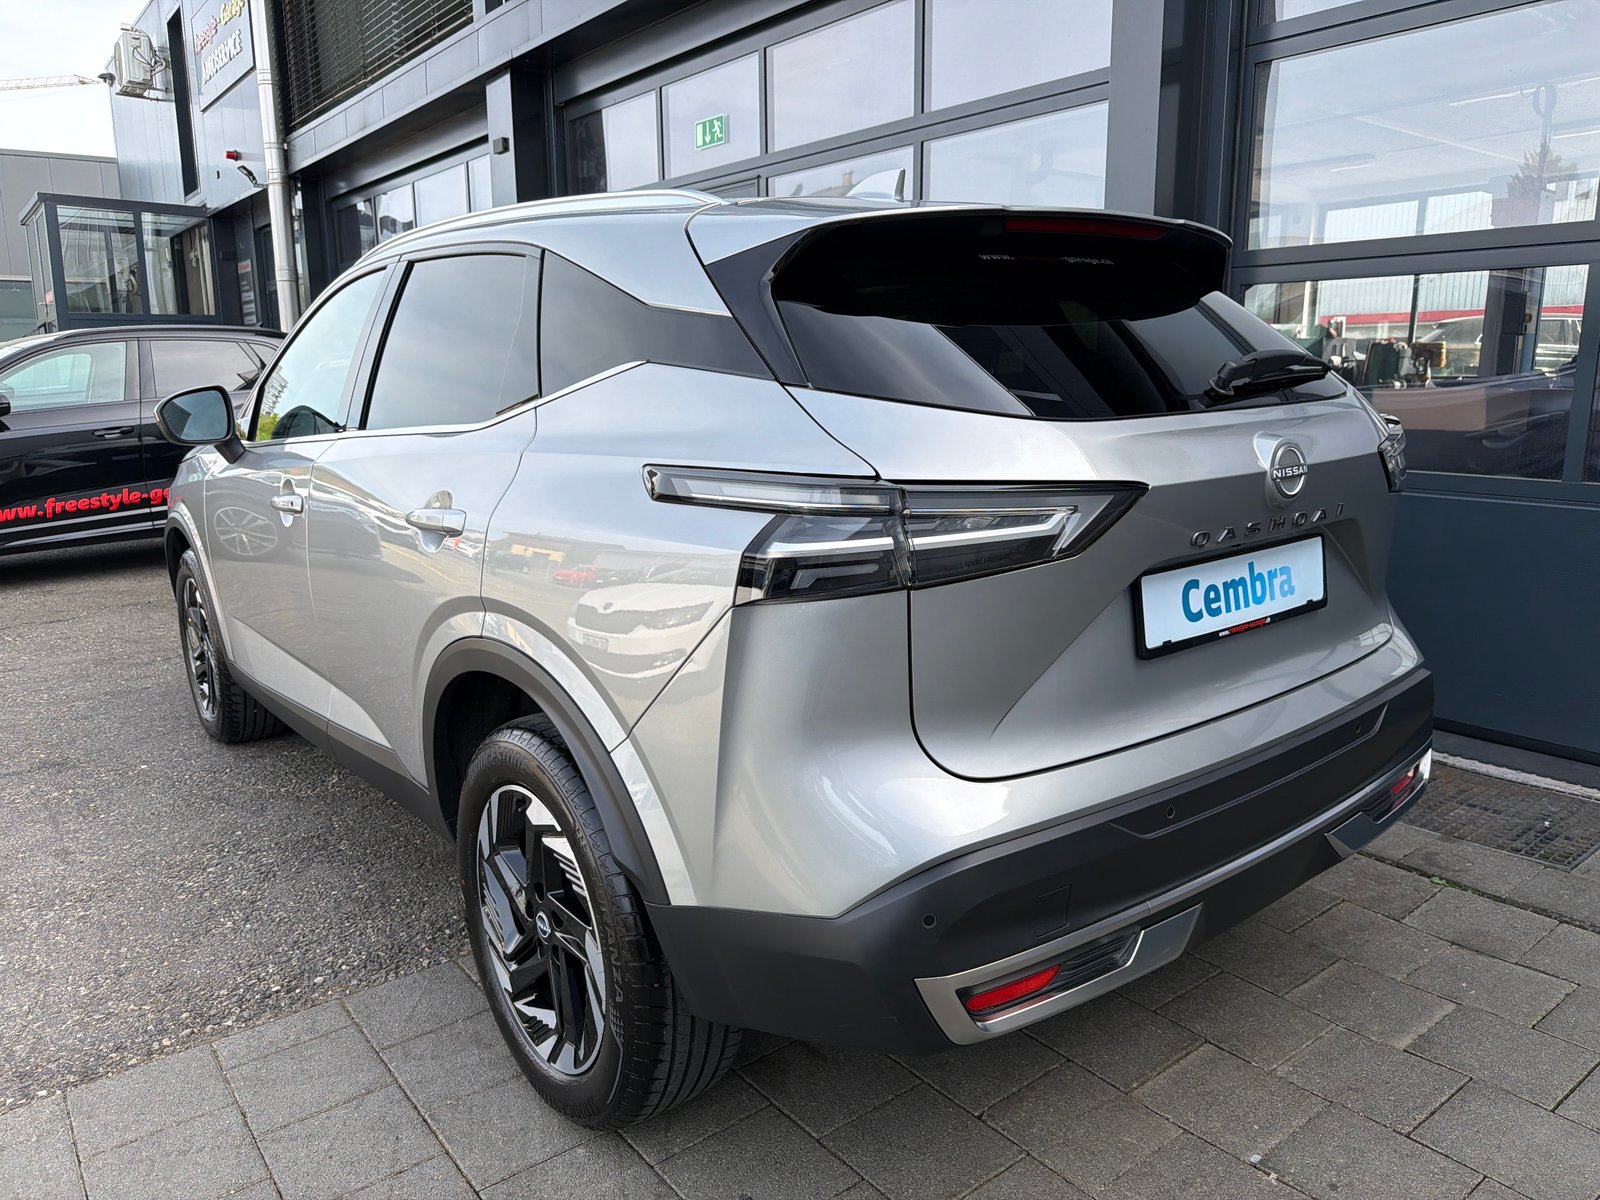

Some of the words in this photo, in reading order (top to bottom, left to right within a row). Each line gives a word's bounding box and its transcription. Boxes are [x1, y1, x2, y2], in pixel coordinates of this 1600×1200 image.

[1272, 465, 1308, 479] NISSAN
[1190, 503, 1344, 547] QASHQAI
[1181, 561, 1296, 623] Cembra
